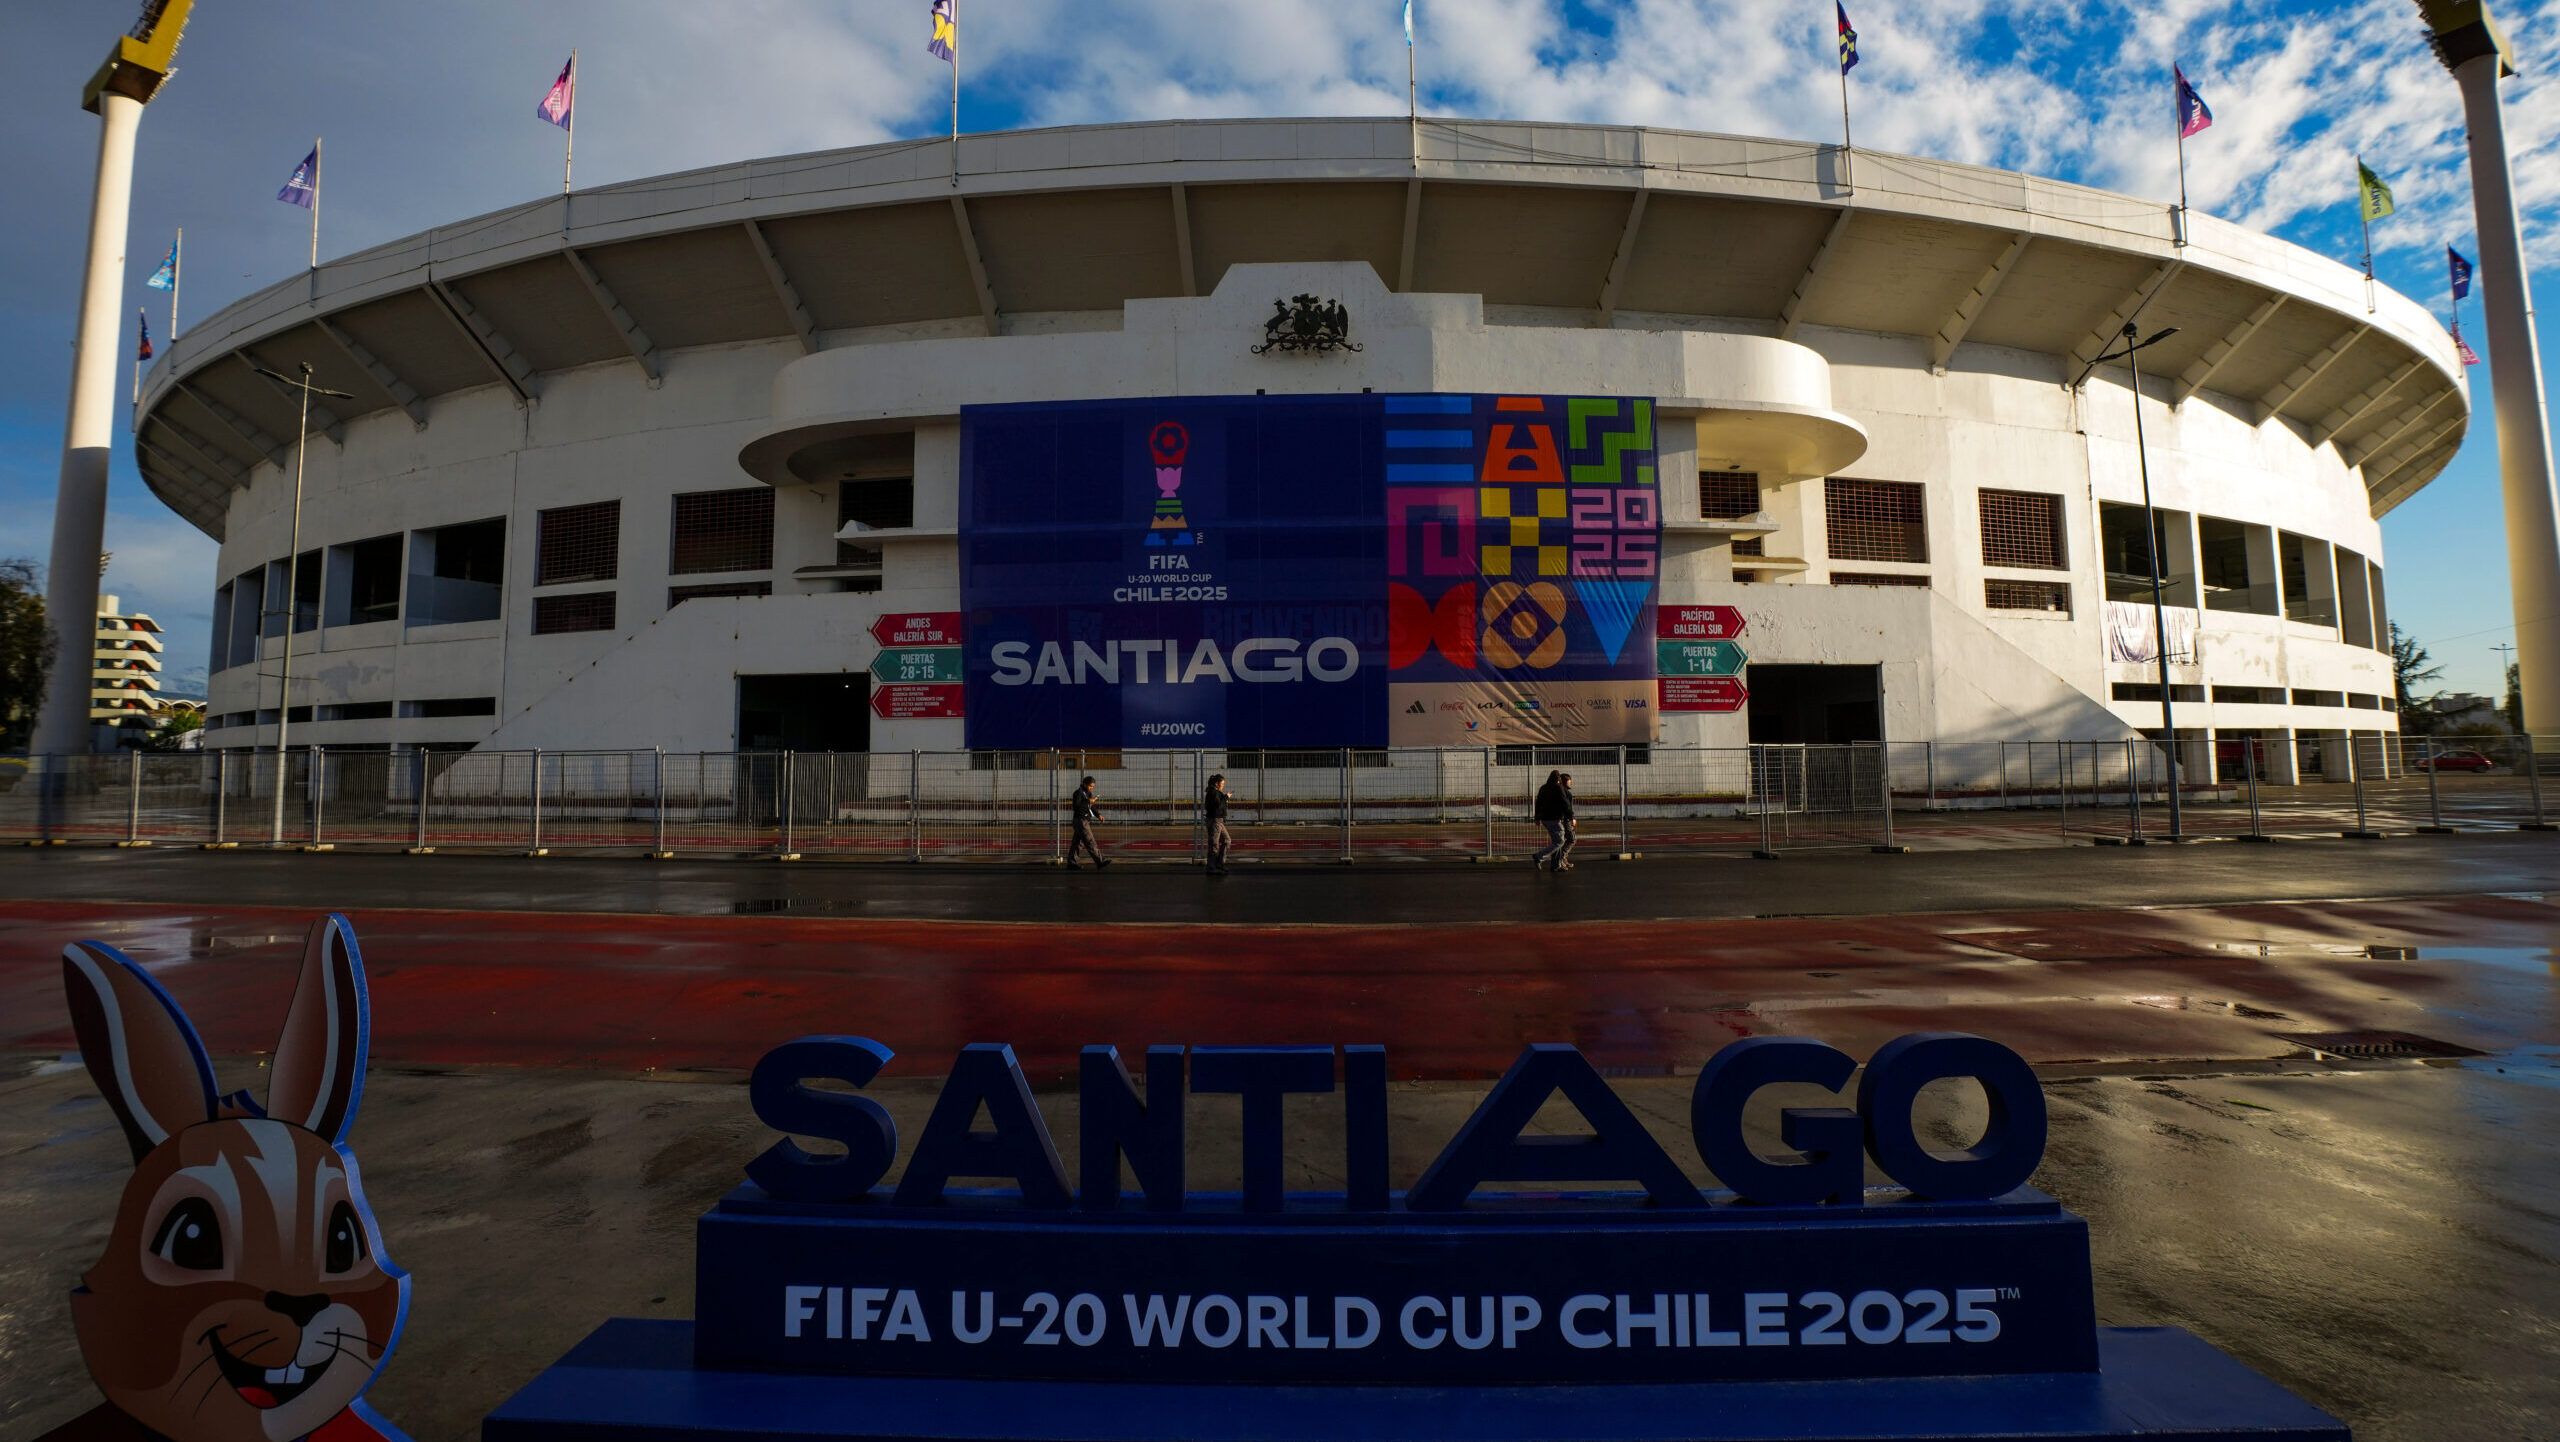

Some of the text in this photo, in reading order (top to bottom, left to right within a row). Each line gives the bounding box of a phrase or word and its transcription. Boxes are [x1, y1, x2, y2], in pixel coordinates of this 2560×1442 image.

[1149, 554, 1190, 570] FIFA
[1128, 573, 1212, 584] U-20 WORLD CUP
[1681, 607, 1715, 621] PACÍFICO
[905, 618, 931, 629] ANDES
[1673, 621, 1723, 635] GALERÍA SUR
[893, 628, 926, 643] GALERÍA
[927, 630, 943, 641] SUR
[900, 653, 935, 664] PUERTAS
[1683, 646, 1717, 657] PUERTAS
[989, 636, 1360, 687] SANTIAGO
[1687, 658, 1714, 672] 1-14
[900, 665, 935, 679] 28-15
[1550, 701, 1576, 709] Lenovo
[1624, 699, 1647, 708] VISA
[1140, 722, 1206, 736] #U20WC
[747, 1032, 2048, 1210] SANTIAGO
[784, 1286, 932, 1342] FIFA
[952, 1291, 1107, 1345] U-20
[1122, 1293, 1382, 1349] WORLD
[1400, 1296, 1542, 1350] CUP
[1559, 1293, 1791, 1349] CHILE
